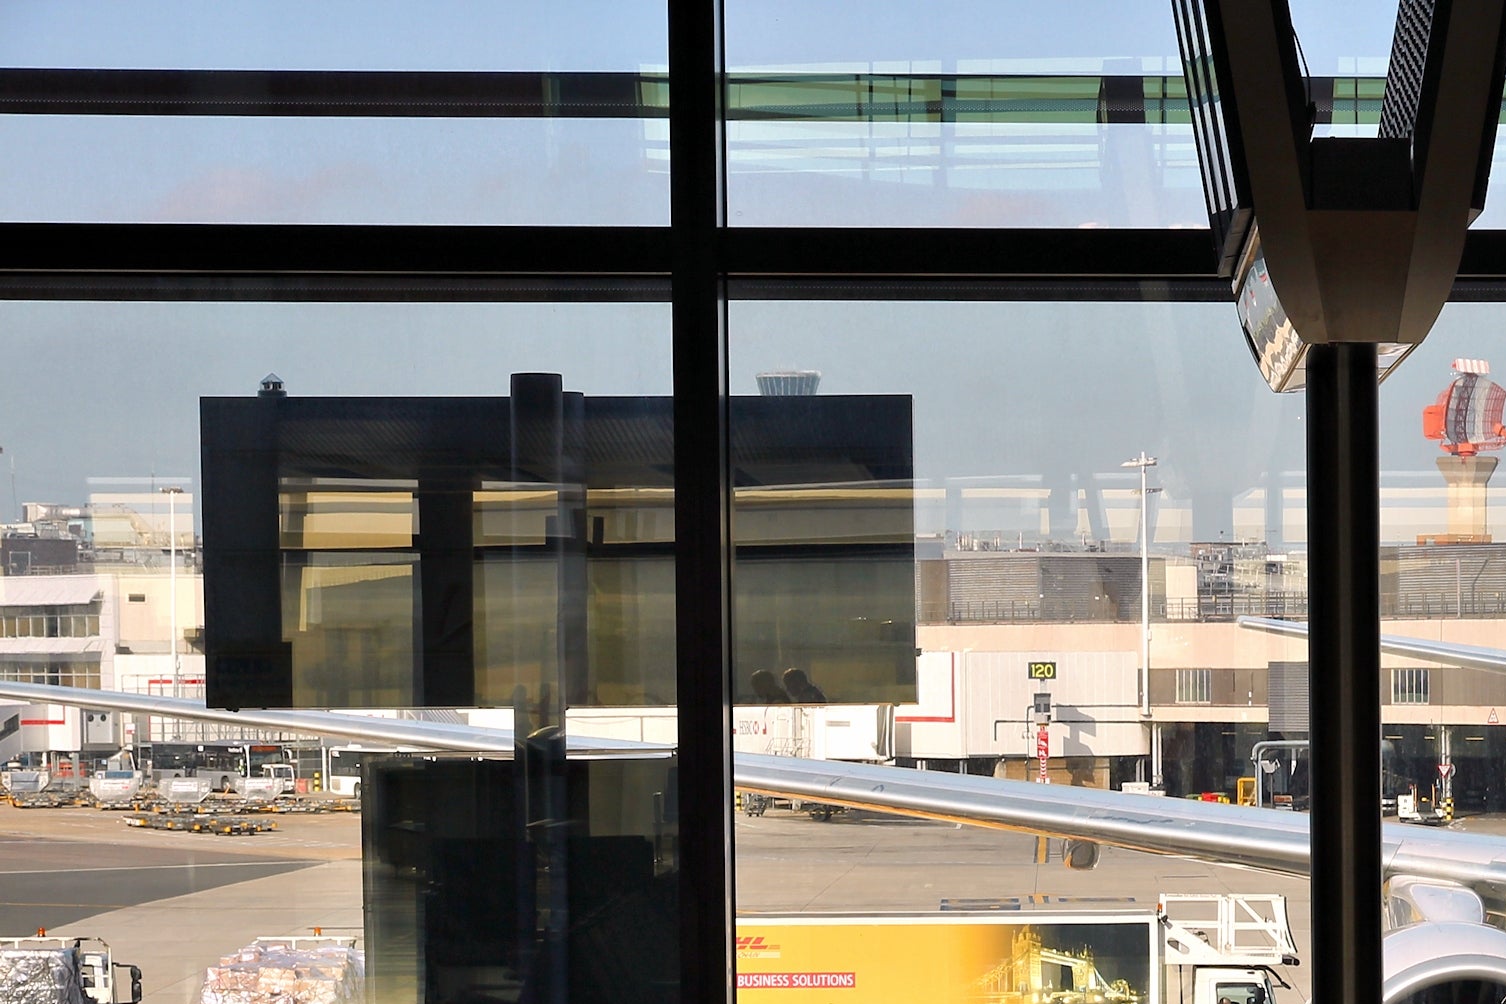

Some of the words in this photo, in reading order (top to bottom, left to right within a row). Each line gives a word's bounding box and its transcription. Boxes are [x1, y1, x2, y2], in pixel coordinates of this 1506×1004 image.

[1030, 663, 1054, 678] 120
[738, 720, 754, 734] HSBC
[737, 974, 789, 987] BUSINESS
[792, 974, 854, 986] SOLUTIONS
